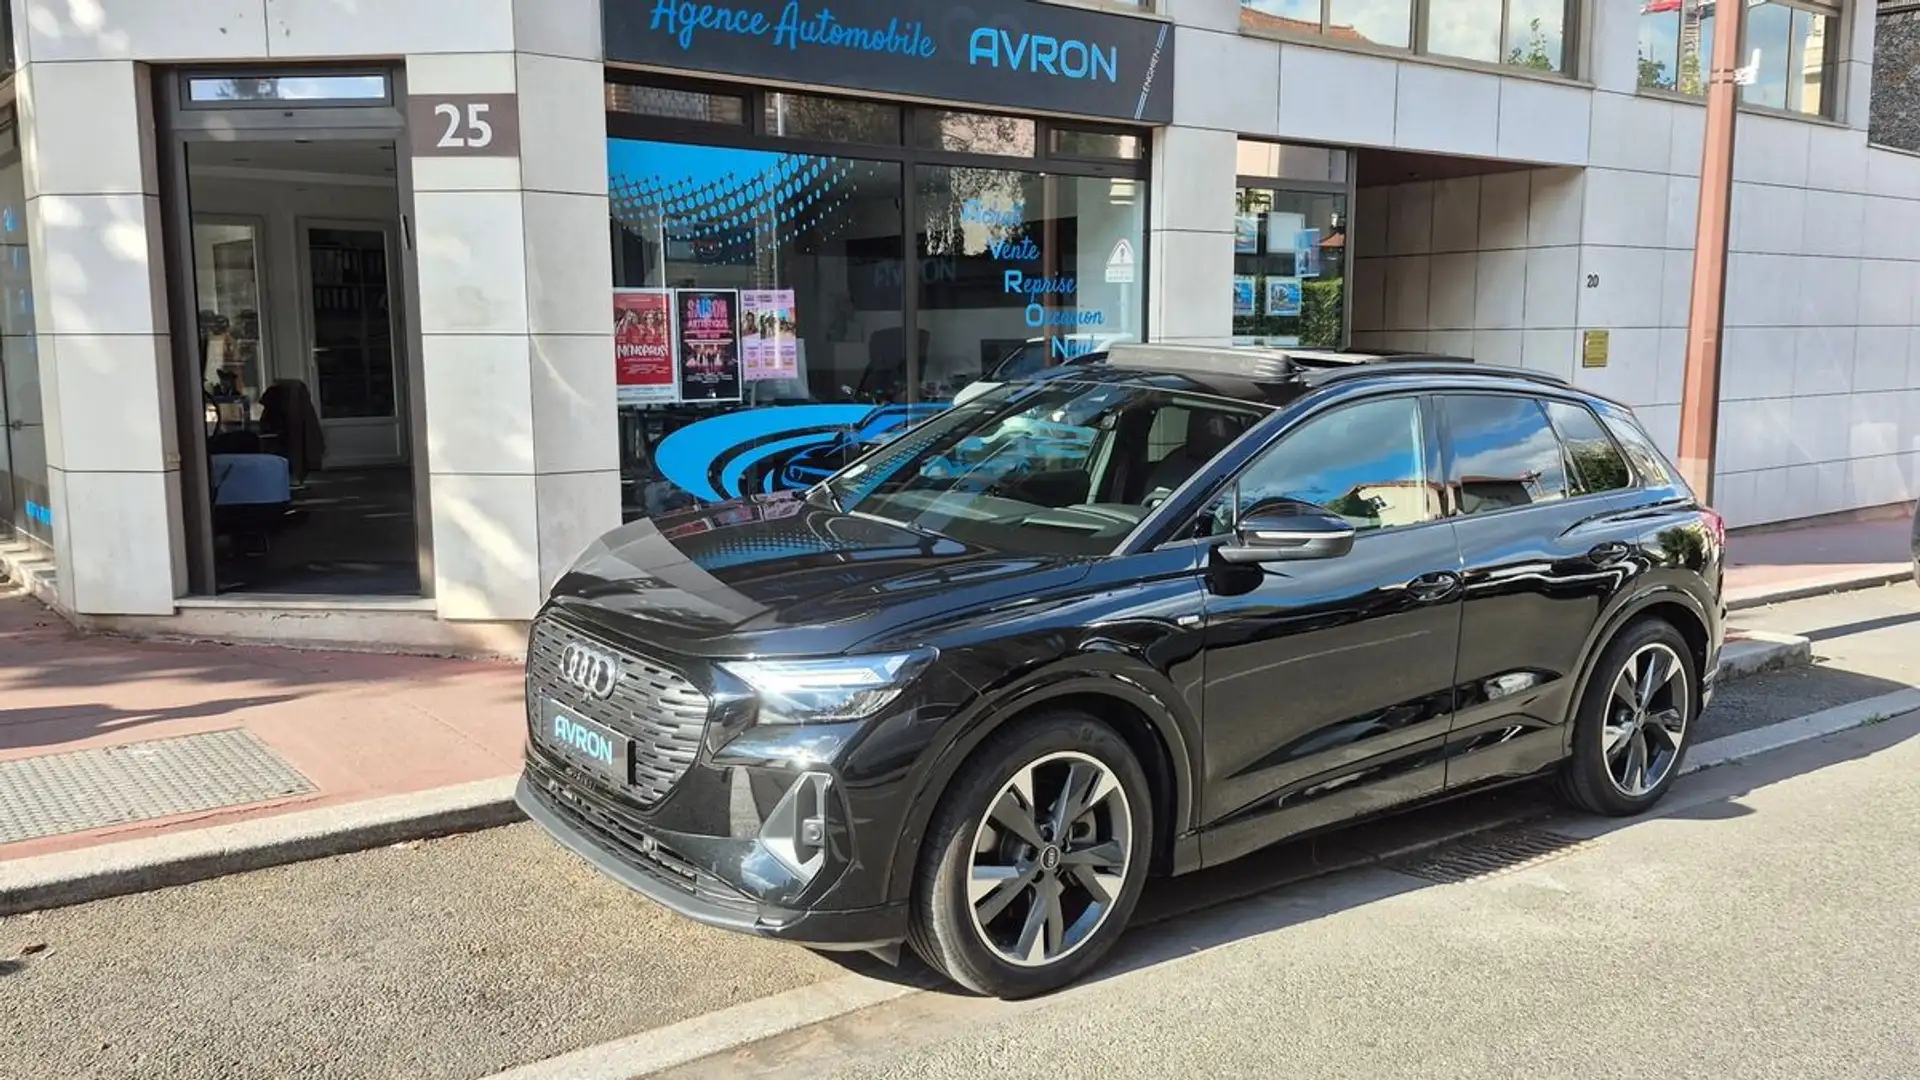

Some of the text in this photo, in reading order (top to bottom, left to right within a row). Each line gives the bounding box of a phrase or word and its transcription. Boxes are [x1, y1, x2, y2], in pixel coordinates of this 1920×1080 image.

[650, 0, 937, 57] Agence Automobile
[969, 27, 1117, 83] AVRON
[435, 103, 492, 147] 25
[987, 235, 1040, 260] Vente
[1004, 270, 1077, 303] Reprise
[1587, 274, 1600, 288] 20
[555, 715, 613, 765] AVRON
